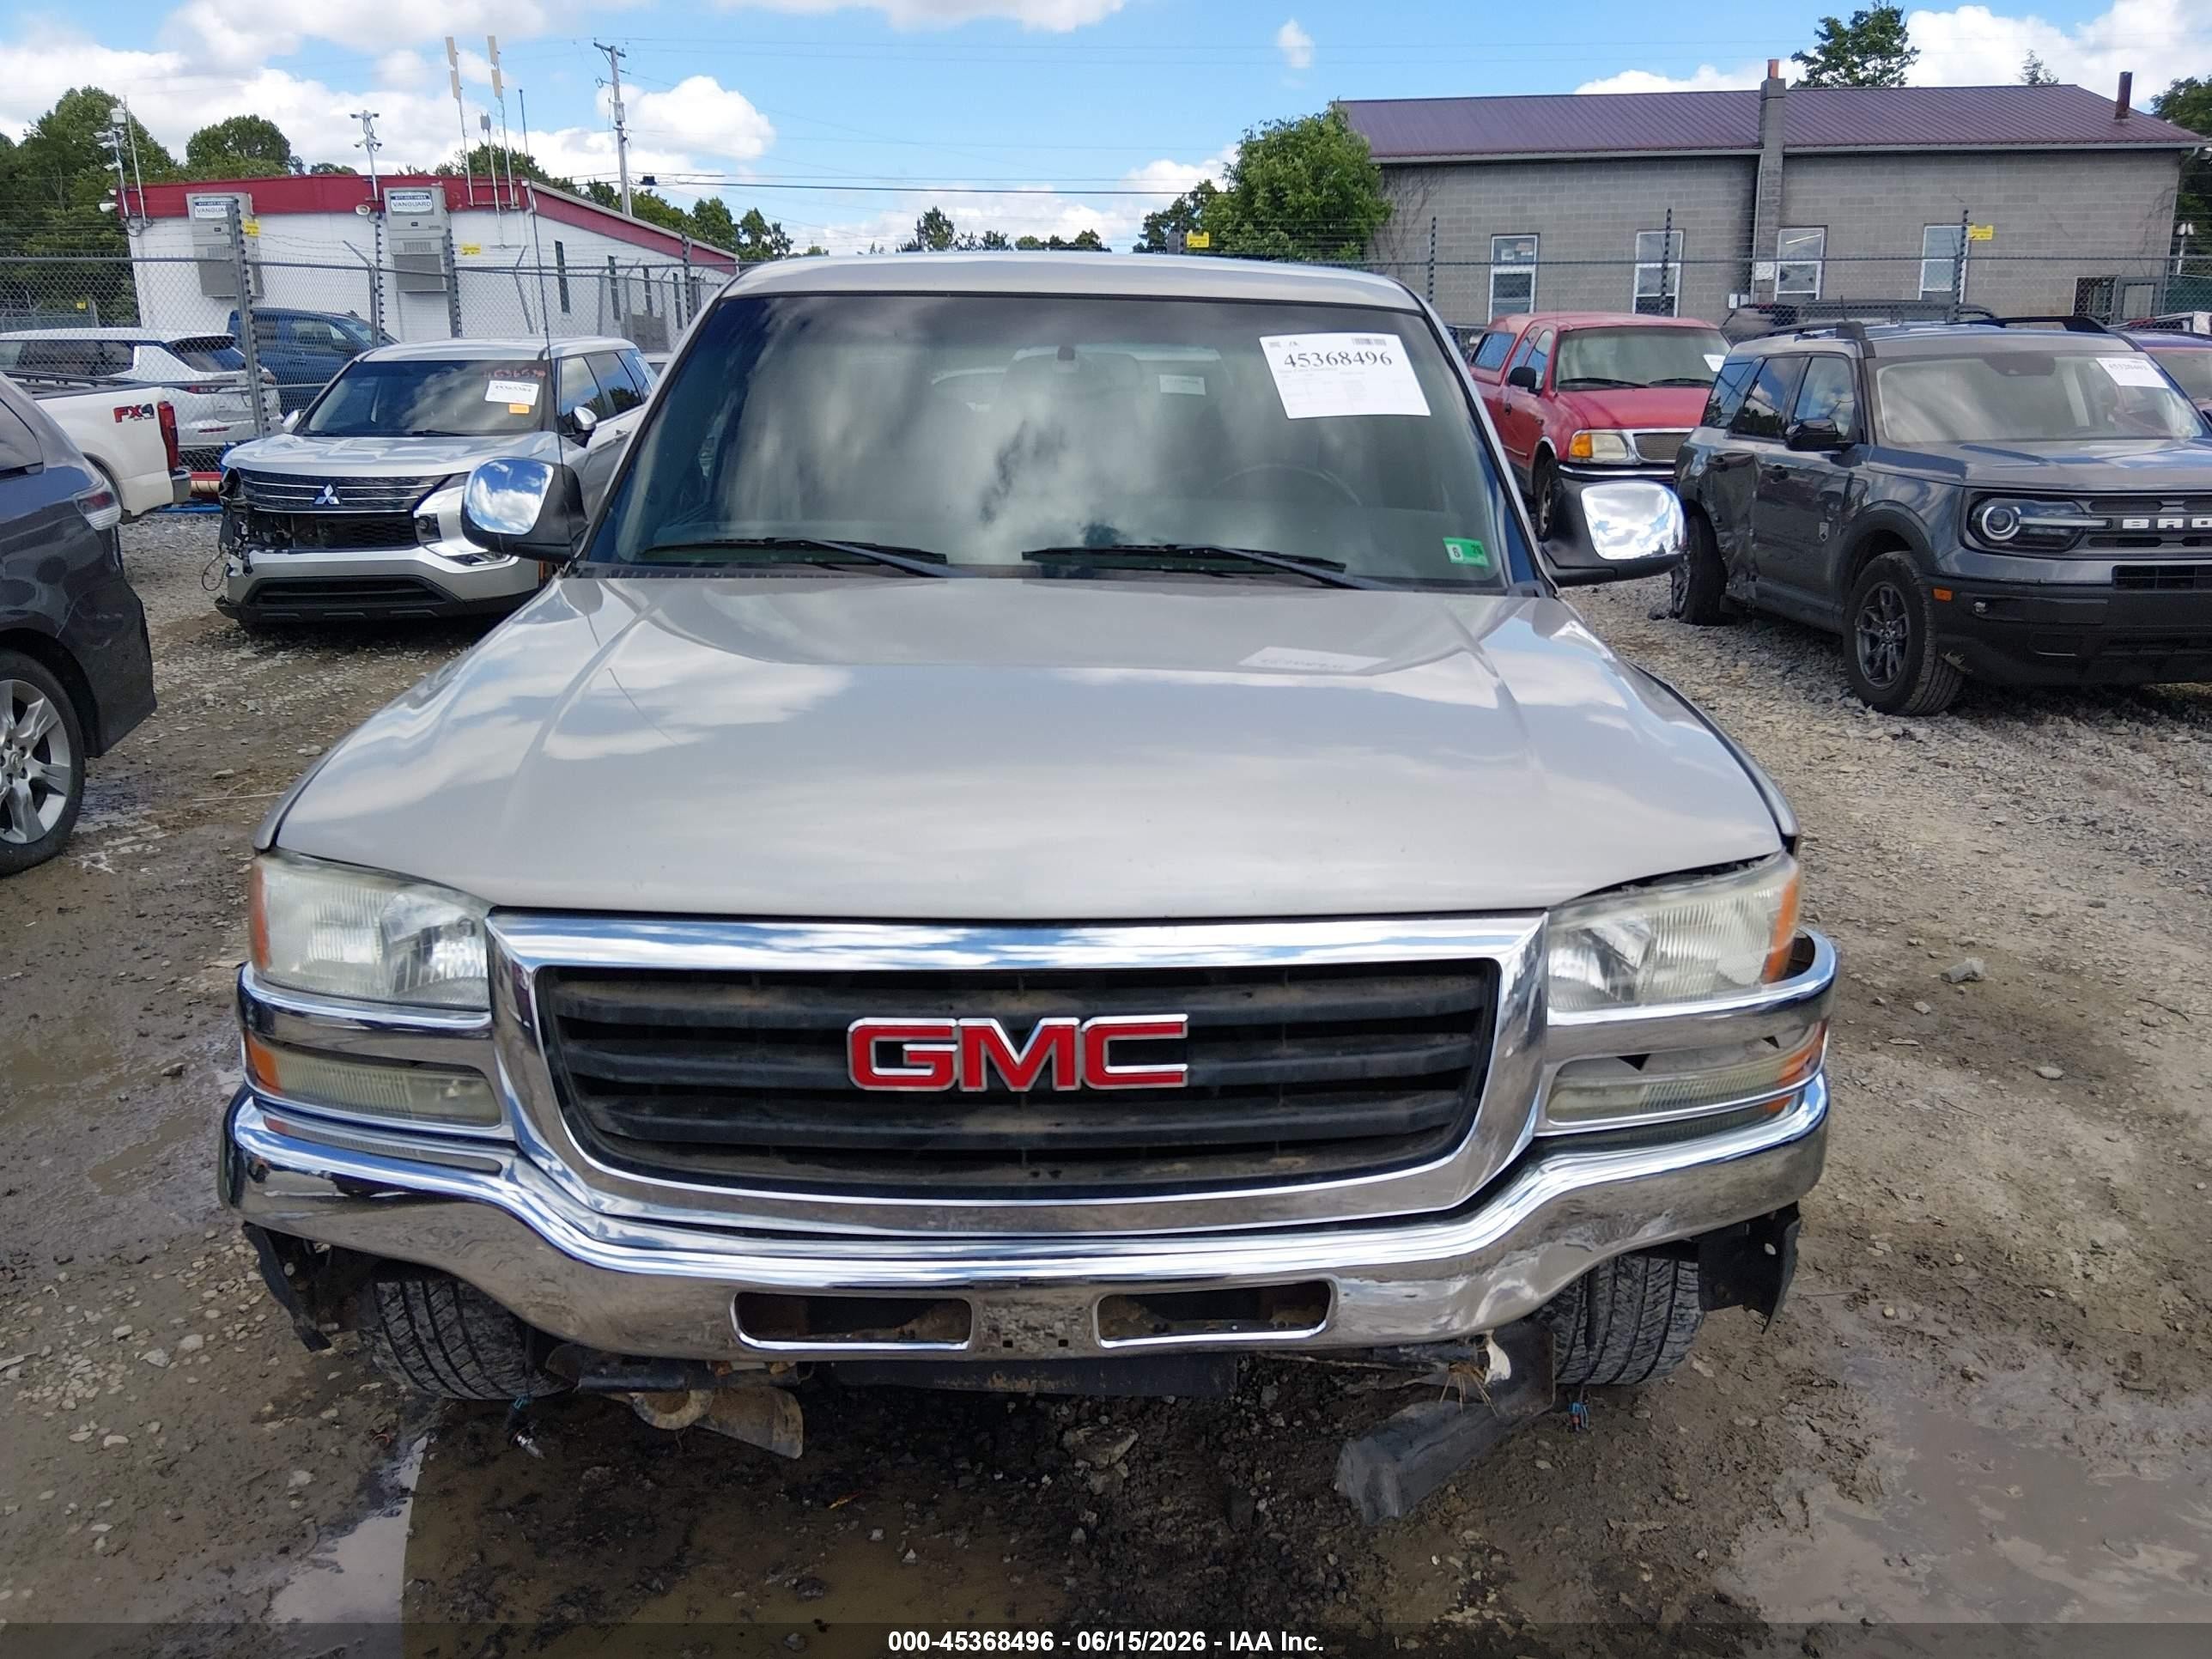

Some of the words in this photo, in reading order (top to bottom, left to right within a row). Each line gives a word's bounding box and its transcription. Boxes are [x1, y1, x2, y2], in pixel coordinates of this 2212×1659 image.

[1284, 350, 1393, 368] 45368496
[112, 403, 155, 422] FX4
[846, 1013, 1189, 1092] GMC
